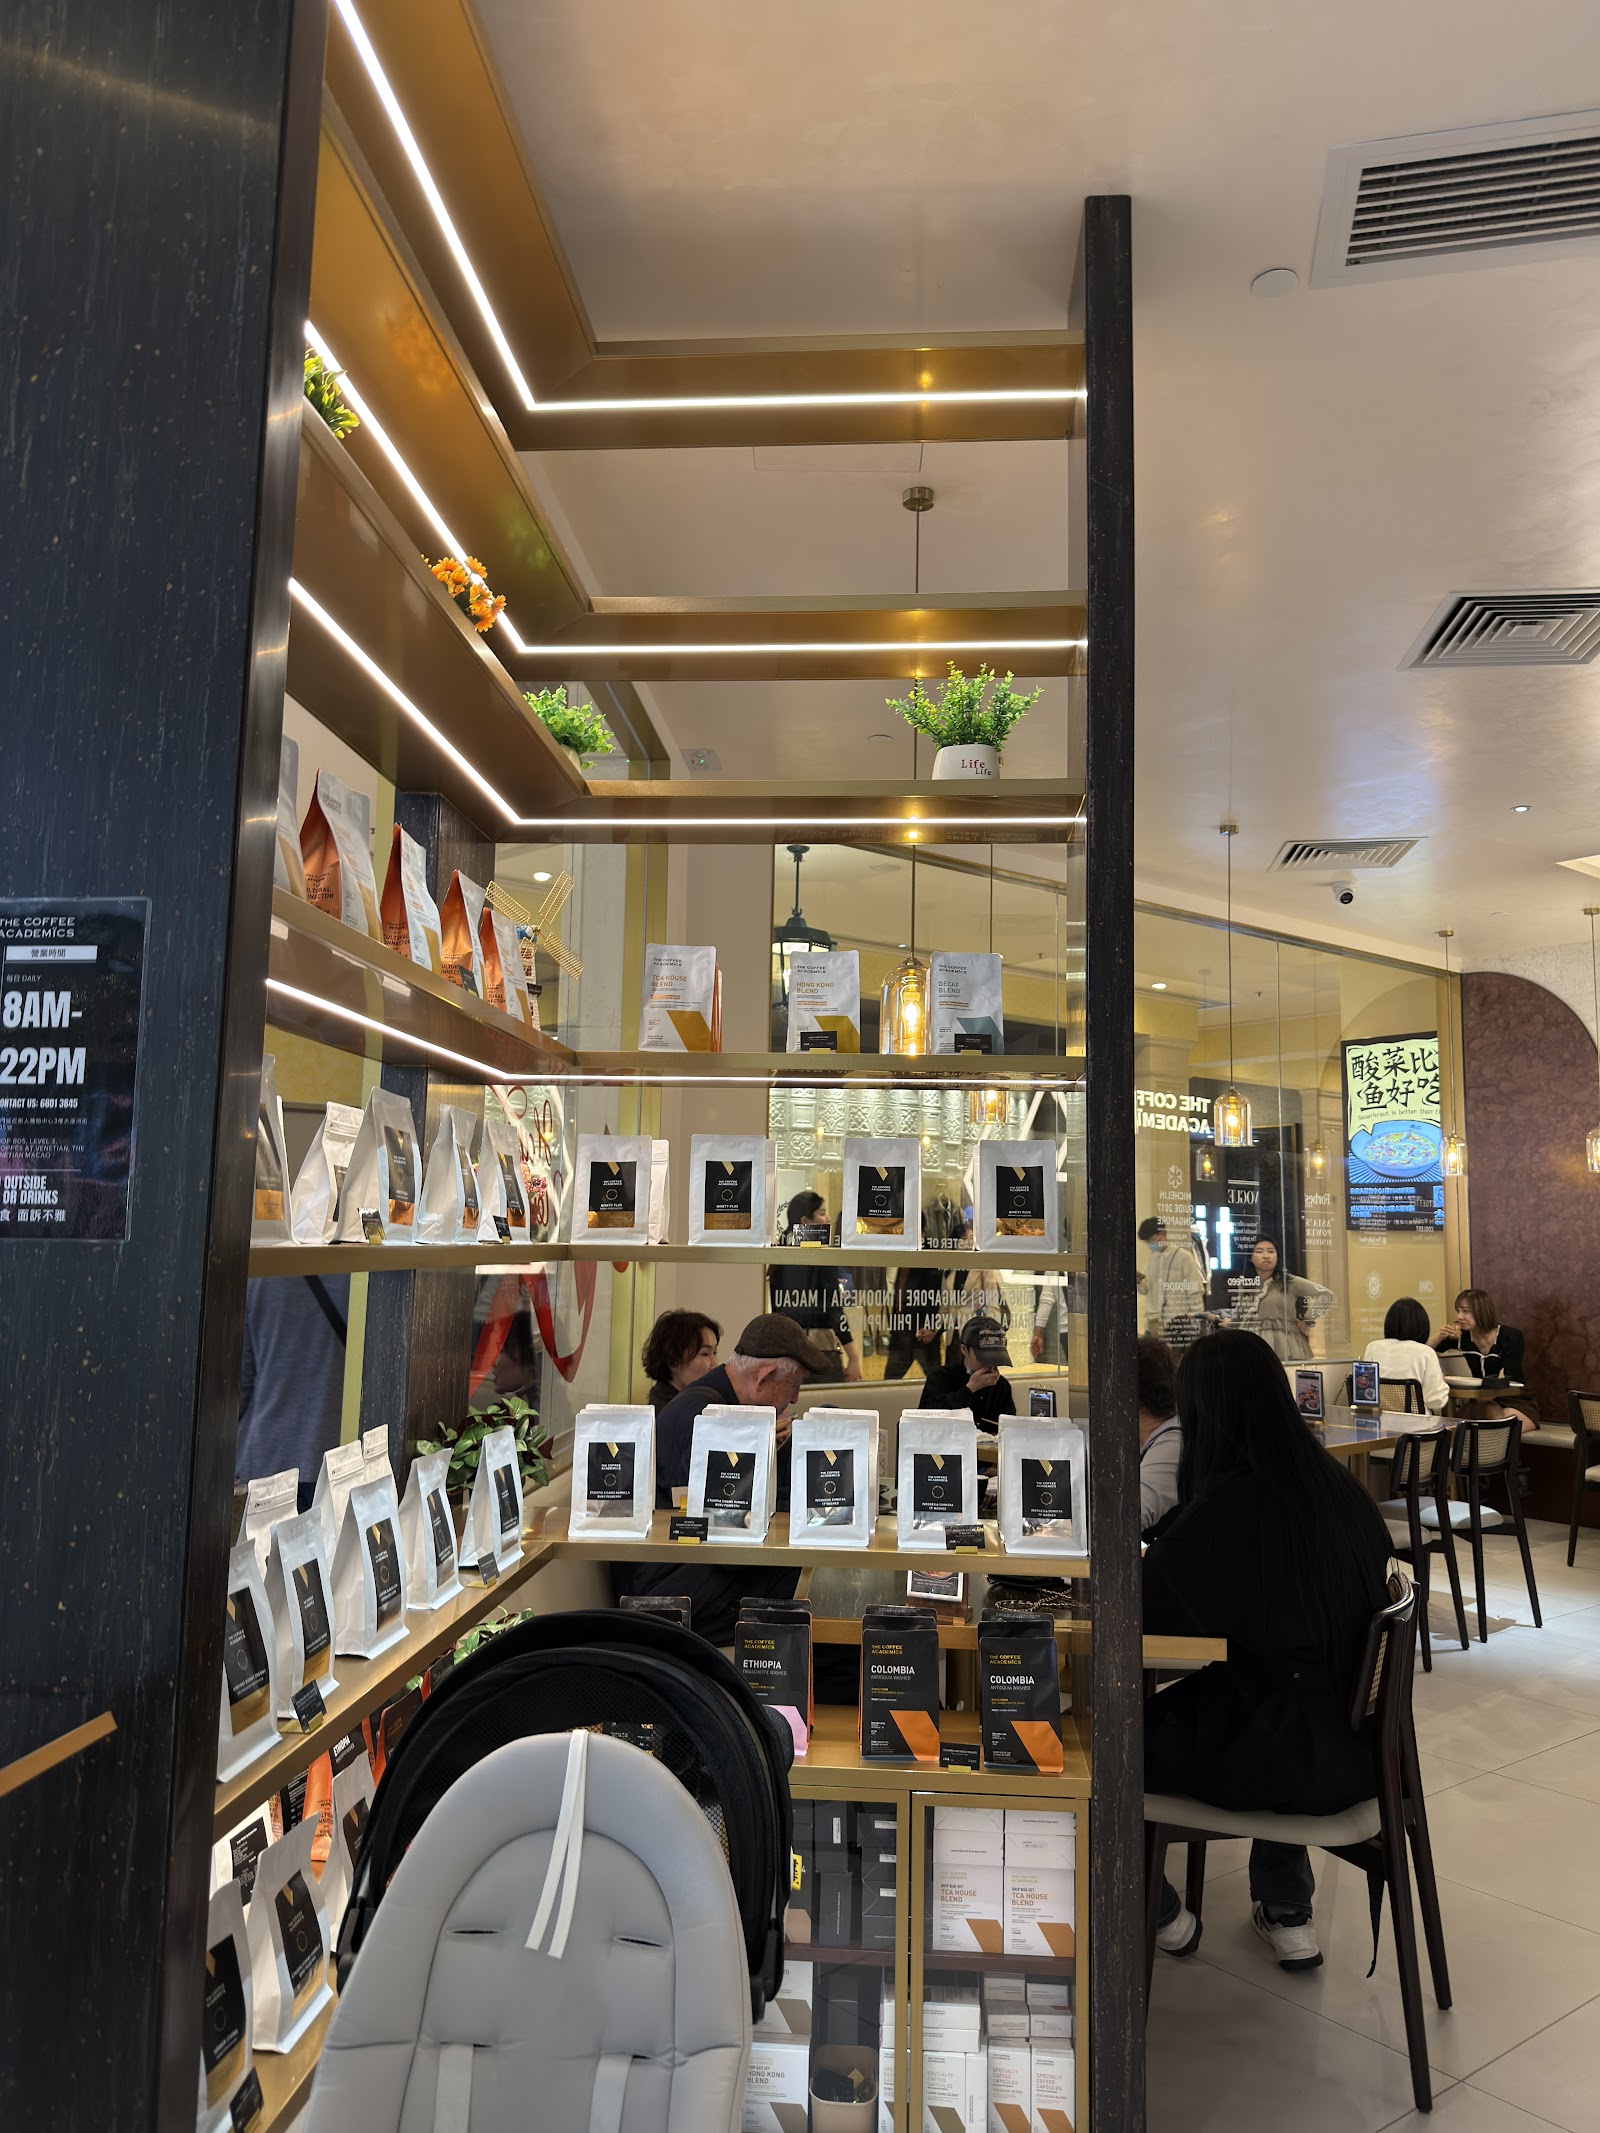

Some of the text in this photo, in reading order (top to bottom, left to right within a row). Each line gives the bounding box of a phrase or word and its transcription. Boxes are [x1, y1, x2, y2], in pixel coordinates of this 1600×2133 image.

[961, 759, 986, 769] Life
[975, 768, 992, 776] Life
[0, 916, 76, 927] THE COFFEE
[31, 948, 66, 958] 營業時間
[22, 974, 41, 982] DAILY
[3, 990, 82, 1029] 8AM-
[0, 1047, 86, 1085] 22PM
[1351, 1046, 1439, 1084] 酸菜比
[0, 1098, 78, 1108] ONTACT US: 6801 3845
[1358, 1111, 1389, 1120] Sauerkraut
[4, 1175, 47, 1190] OUTSIDE
[3, 1190, 59, 1204] OR DRINKS
[743, 1659, 782, 1669] ETHIOPIA
[870, 1665, 915, 1675] COLOMBIA
[990, 1675, 1035, 1685] COLOMBIA
[332, 1735, 351, 1757] ETHIOPIA
[955, 1889, 977, 1897] HOUSE
[940, 1895, 963, 1903] BLEND
[1011, 1899, 1034, 1907] BLEND
